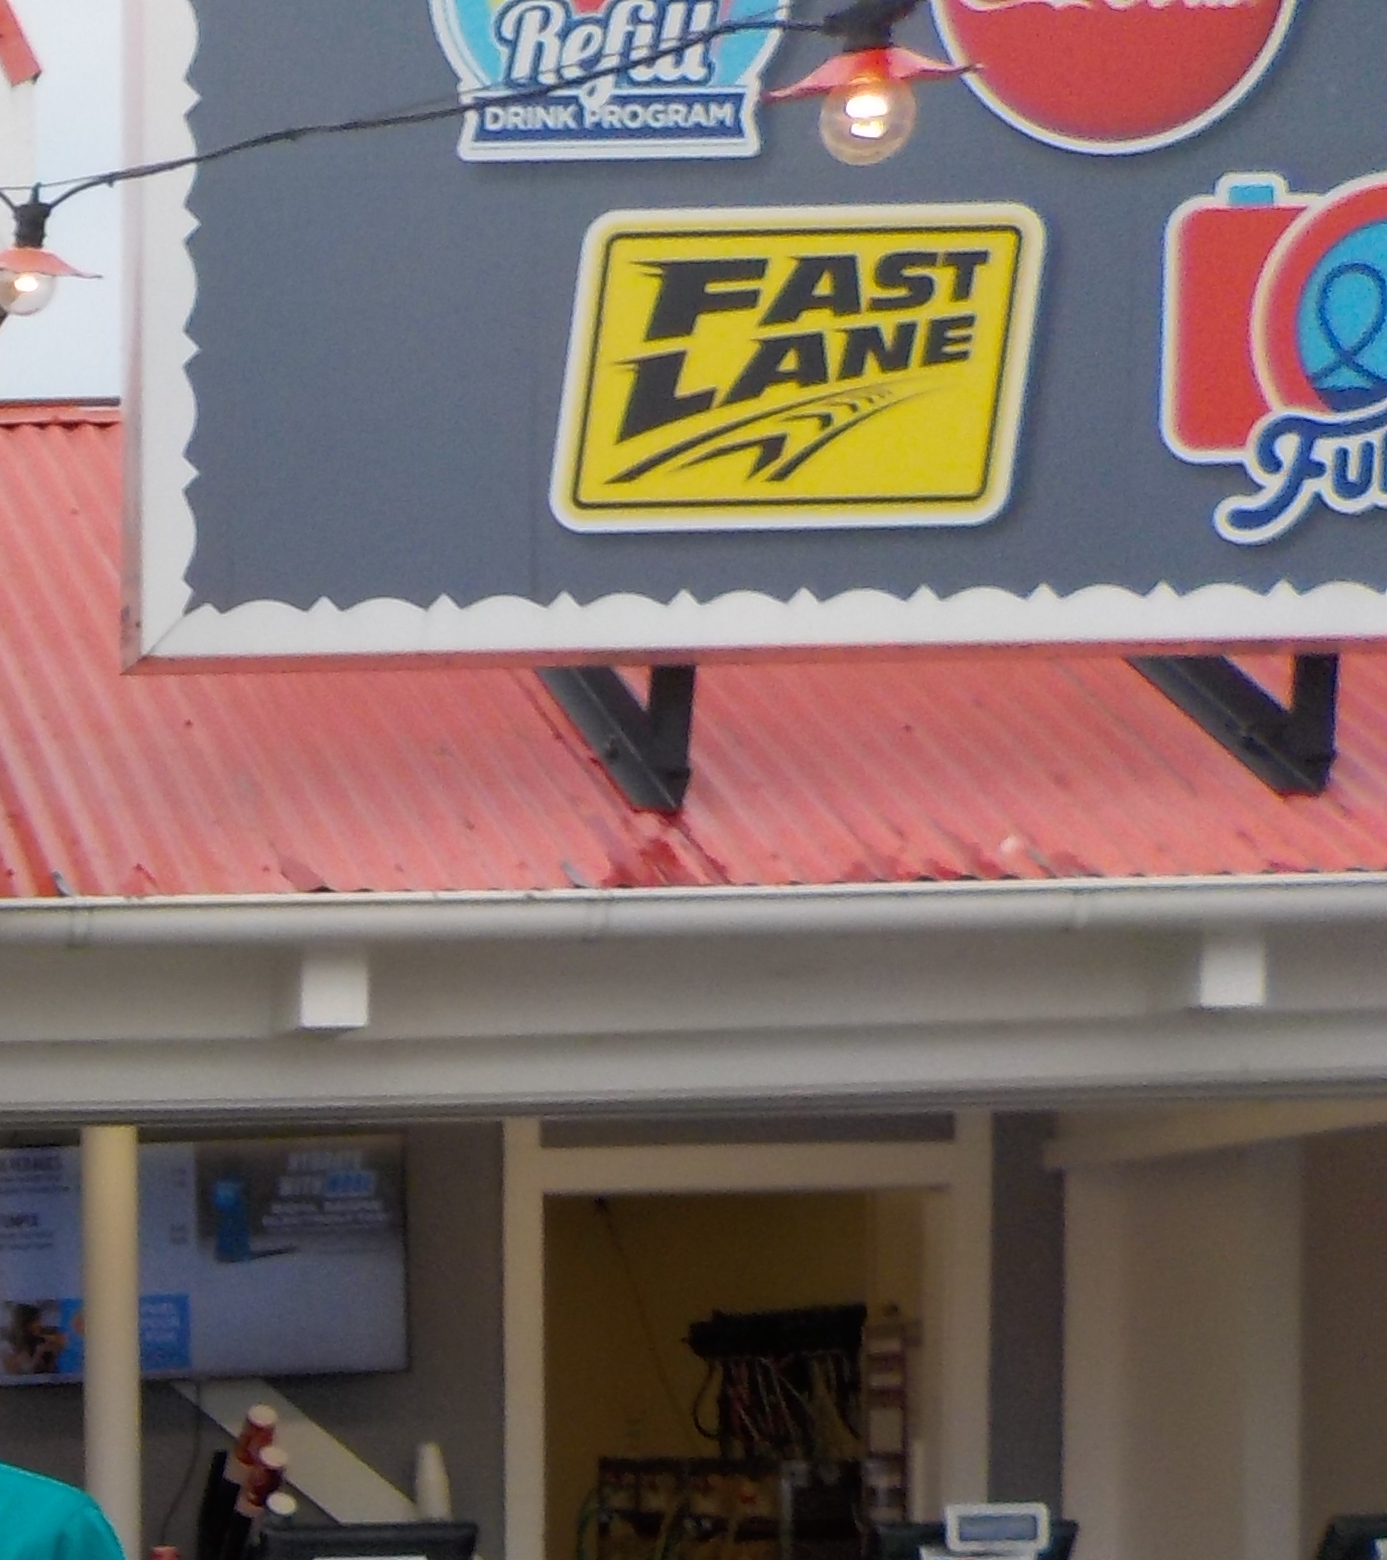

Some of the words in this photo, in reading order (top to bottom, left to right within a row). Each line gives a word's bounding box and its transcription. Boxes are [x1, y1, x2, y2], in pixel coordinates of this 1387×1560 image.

[497, 0, 717, 107] Refill
[484, 104, 579, 131] DRINK
[586, 101, 734, 130] PROGRAM
[631, 249, 990, 342] FAST
[614, 313, 976, 445] LANE
